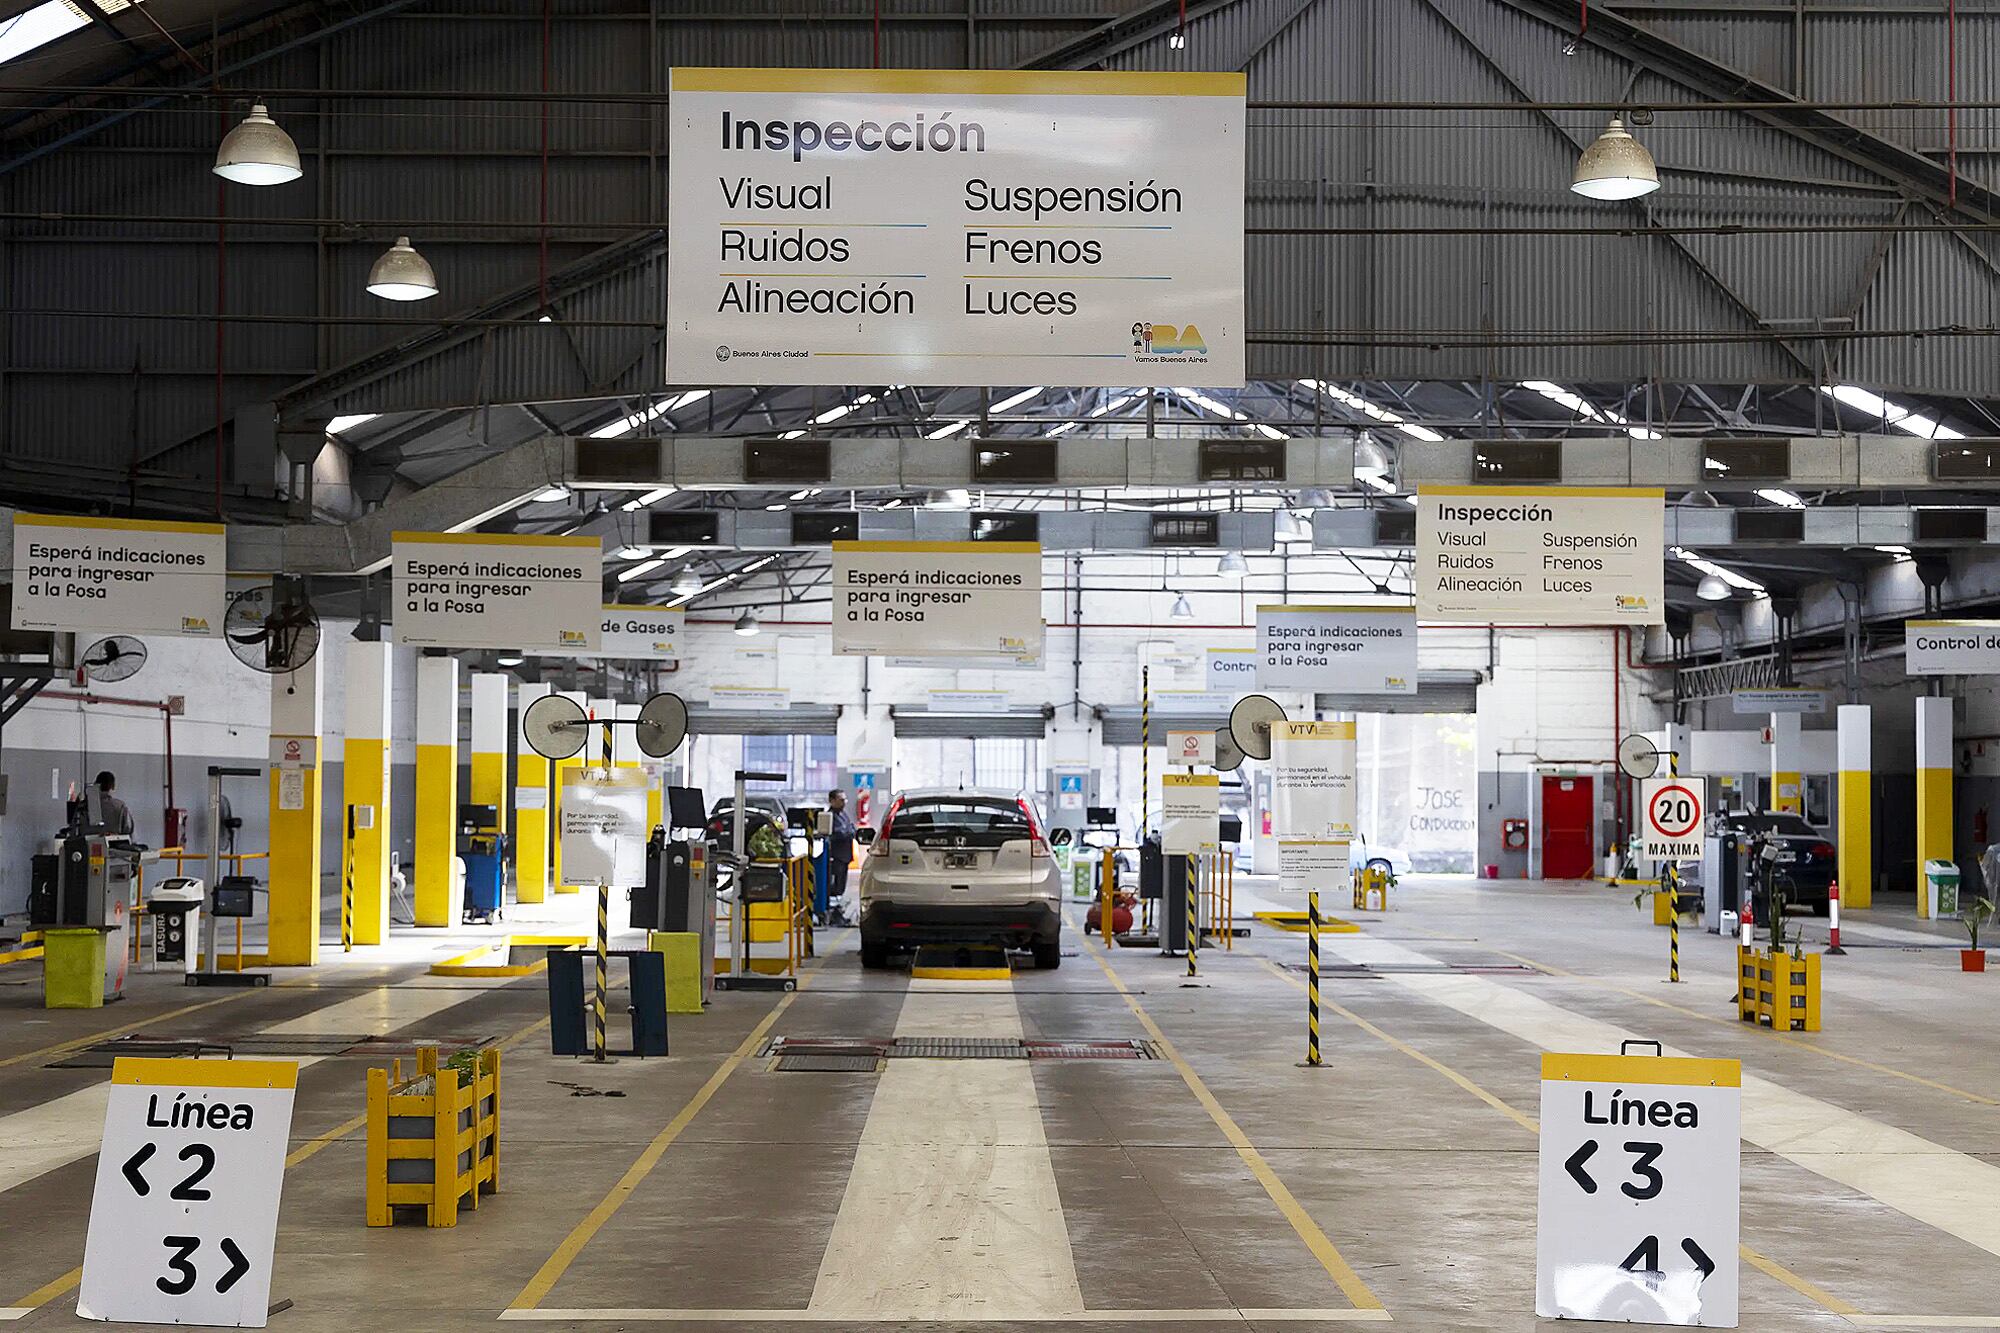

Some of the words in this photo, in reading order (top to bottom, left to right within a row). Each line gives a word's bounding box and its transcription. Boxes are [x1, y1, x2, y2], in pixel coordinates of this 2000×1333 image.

[719, 110, 986, 163] Inspección
[719, 176, 832, 210] Visual
[964, 179, 1183, 221] Suspensión
[720, 229, 850, 263] Ruidos
[965, 231, 1102, 265] Frenos
[718, 282, 914, 315] Alineación
[965, 283, 1078, 316] Luces
[732, 349, 759, 358] Buenos
[761, 349, 780, 358] Aires
[782, 350, 809, 359] Ciudad
[1134, 355, 1159, 363] Vamos
[1438, 503, 1553, 525] Inspección
[1437, 531, 1486, 546] Visual
[1543, 532, 1638, 550] Suspensión
[28, 543, 92, 562] Esperá
[97, 546, 206, 566] indicaciones
[1438, 554, 1494, 569] Ruidos
[1543, 555, 1603, 570] Frenos
[28, 564, 72, 581] para
[77, 566, 155, 584] ingresar
[407, 560, 469, 580] Esperá
[475, 562, 583, 579] indicaciones
[847, 569, 909, 587] Esperá
[915, 570, 1022, 585] indicaciones
[28, 584, 40, 596] a
[45, 581, 60, 597] la
[66, 584, 107, 599] fosa
[407, 580, 451, 598] para
[455, 582, 532, 600] ingresar
[1437, 577, 1522, 592] Alineación
[1543, 578, 1593, 592] Luces
[225, 591, 264, 602] ases
[847, 590, 890, 606] para
[896, 589, 972, 607] ingresar
[407, 600, 418, 612] a
[423, 598, 439, 613] la
[444, 599, 485, 614] fosa
[847, 610, 858, 622] a
[864, 607, 879, 622] la
[884, 608, 925, 622] fosa
[601, 619, 621, 633] de
[626, 620, 675, 635] Gases
[1267, 625, 1316, 640] Esperá
[1320, 626, 1403, 638] indicaciones
[1267, 641, 1301, 653] para
[1305, 641, 1364, 654] ingresar
[1916, 636, 1981, 651] Control
[1267, 656, 1277, 666] a
[1281, 655, 1293, 666] la
[1296, 655, 1328, 667] fosa
[1289, 724, 1315, 735] VTV
[1658, 799, 1691, 824] 20
[1648, 843, 1701, 857] MAXIMA
[157, 913, 166, 953] BASURA
[146, 1091, 254, 1131] Línea
[1583, 1088, 1699, 1129] Línea
[169, 1143, 216, 1202] 2
[1620, 1141, 1664, 1201] 3
[155, 1235, 201, 1296] 3
[1617, 1234, 1667, 1292] 4
